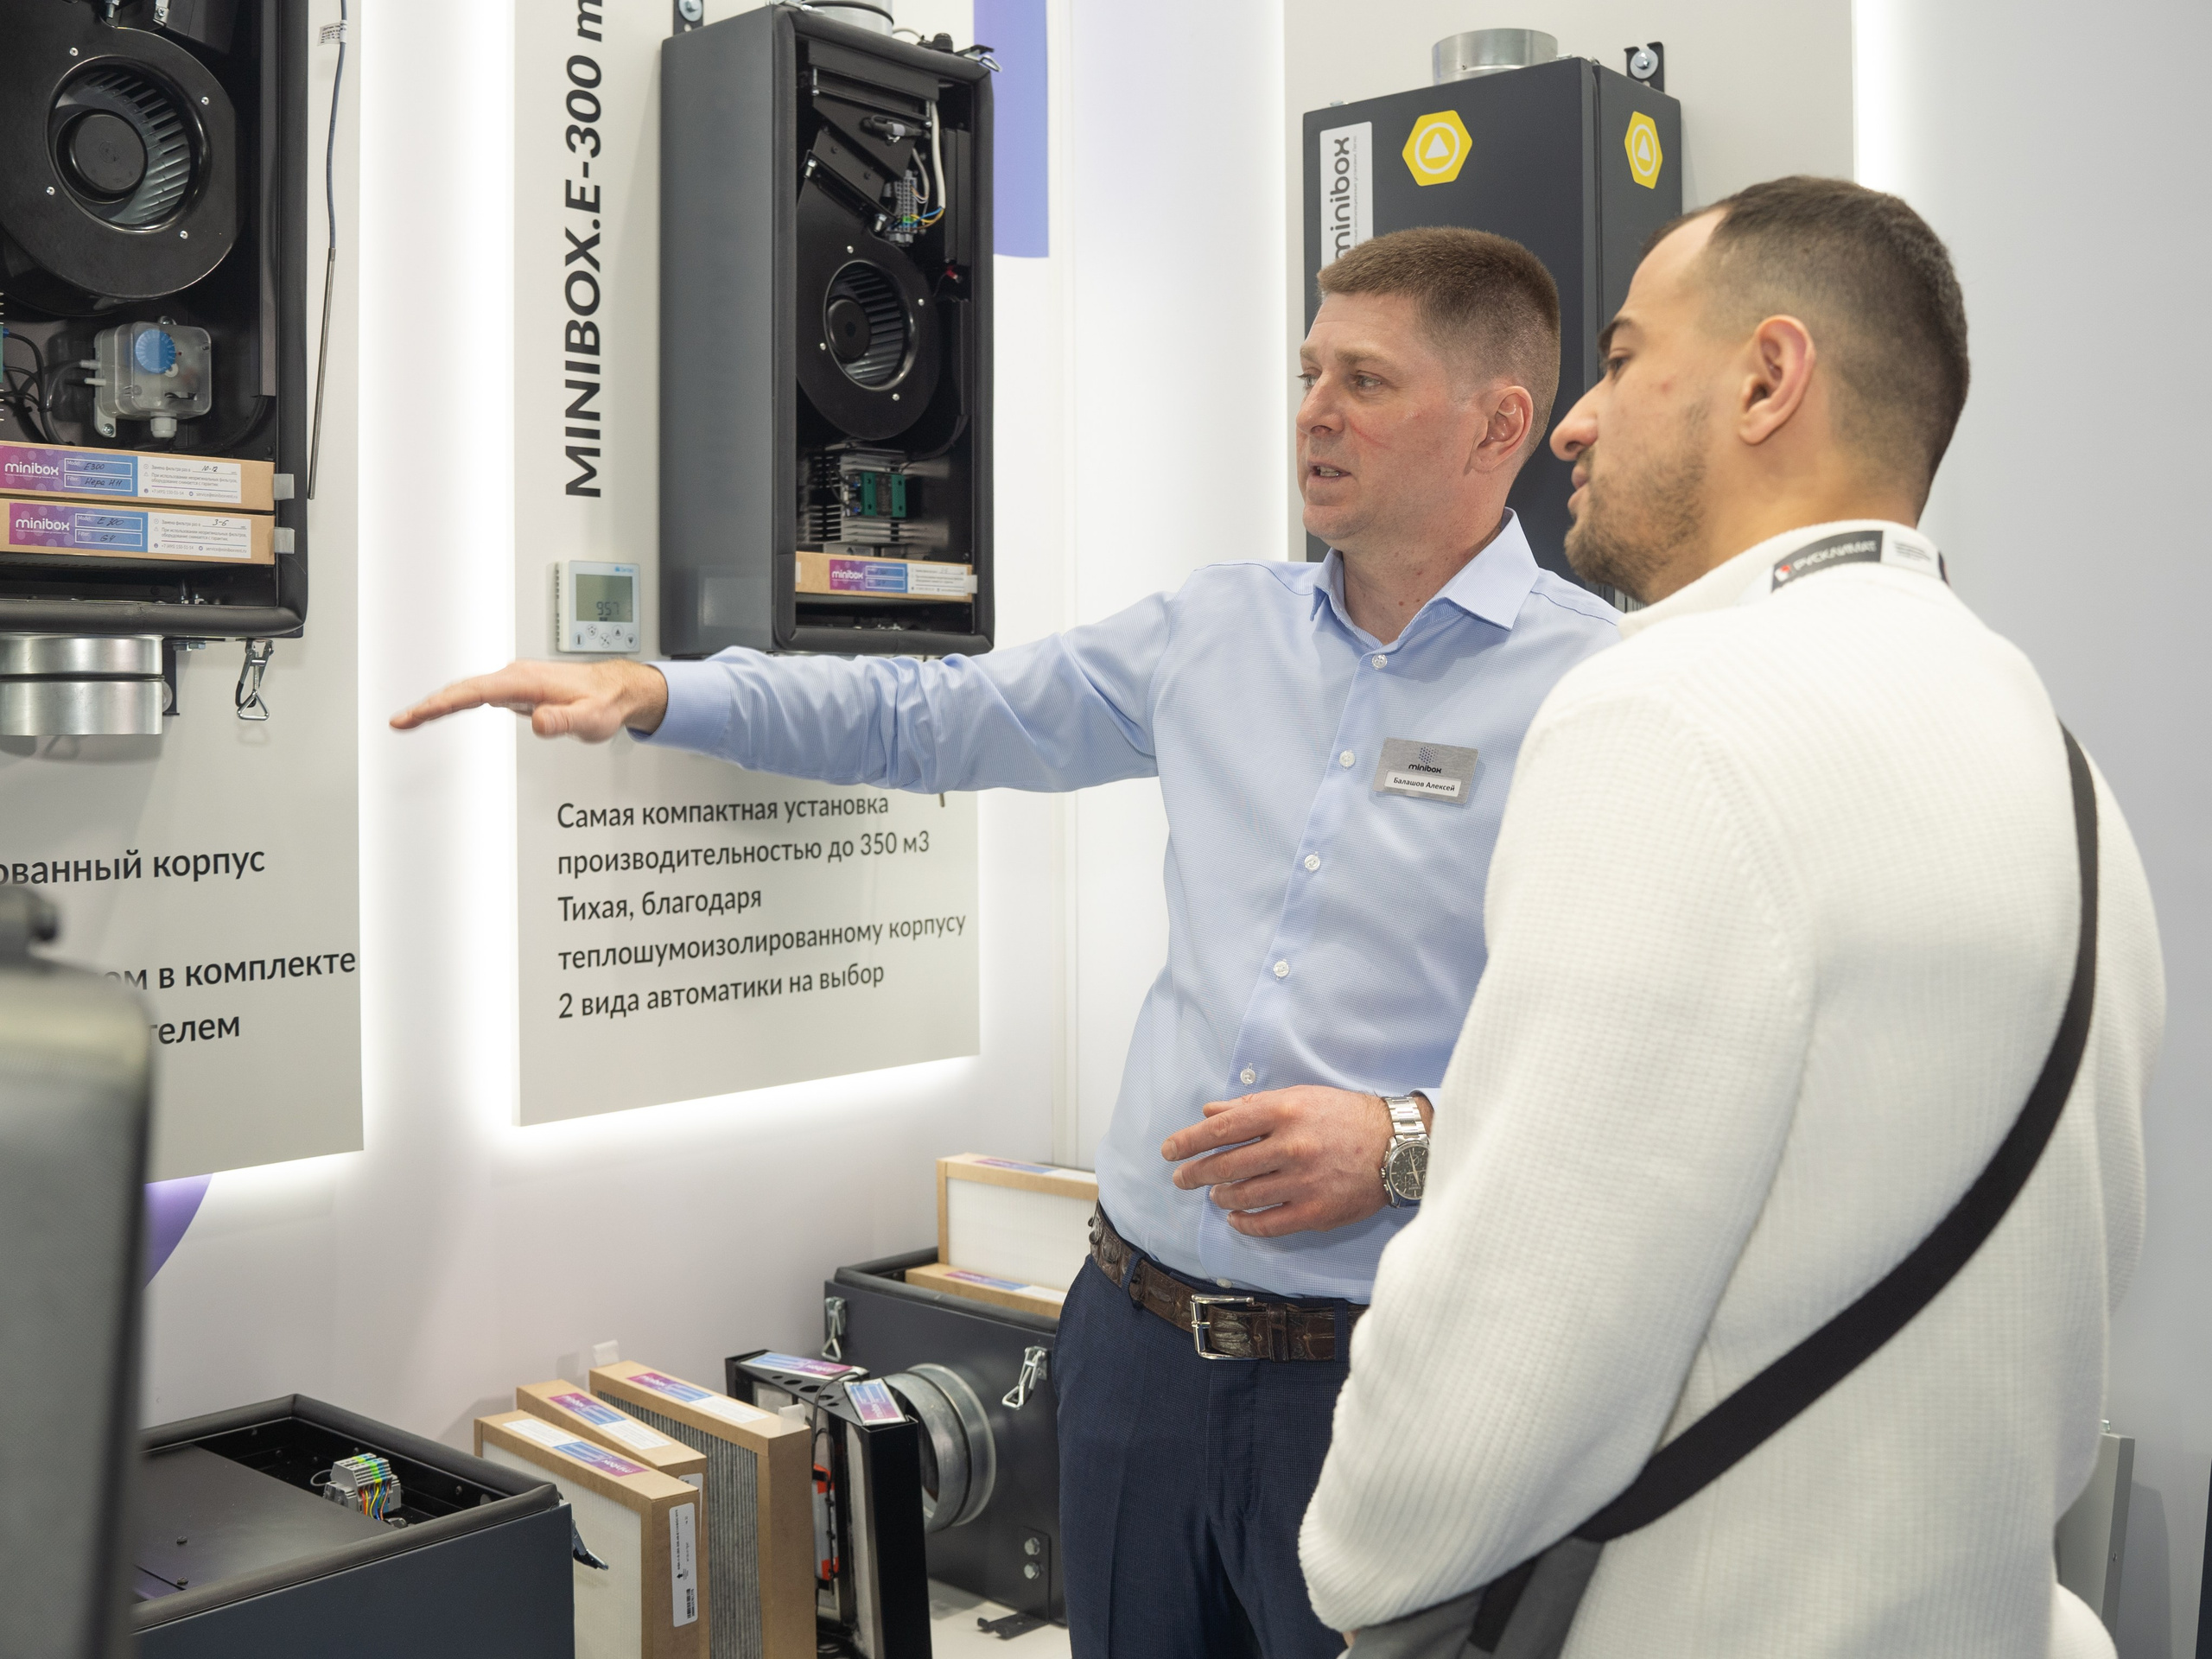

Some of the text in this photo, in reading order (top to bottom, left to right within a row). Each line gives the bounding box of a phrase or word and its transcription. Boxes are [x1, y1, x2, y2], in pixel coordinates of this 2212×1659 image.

[564, 54, 602, 498] MINIBOX.E-300
[4, 461, 60, 476] minibox
[84, 462, 105, 471] E300
[16, 517, 70, 531] minibox
[212, 518, 230, 527] 3-6
[831, 569, 863, 580] minibox
[1393, 777, 1455, 791] Балашов Алексей
[1408, 763, 1442, 773] minibox
[557, 794, 889, 829] Самая компактная установка
[153, 850, 266, 882] корпус
[557, 830, 931, 879] производительностью до 350 м3
[557, 888, 763, 922] Тихая, благодаря
[558, 912, 967, 970] теплошумоизолированному корпусу
[158, 966, 175, 989] в
[185, 952, 357, 988] комплекте
[558, 962, 885, 1019] 2 вида автоматики на выбор
